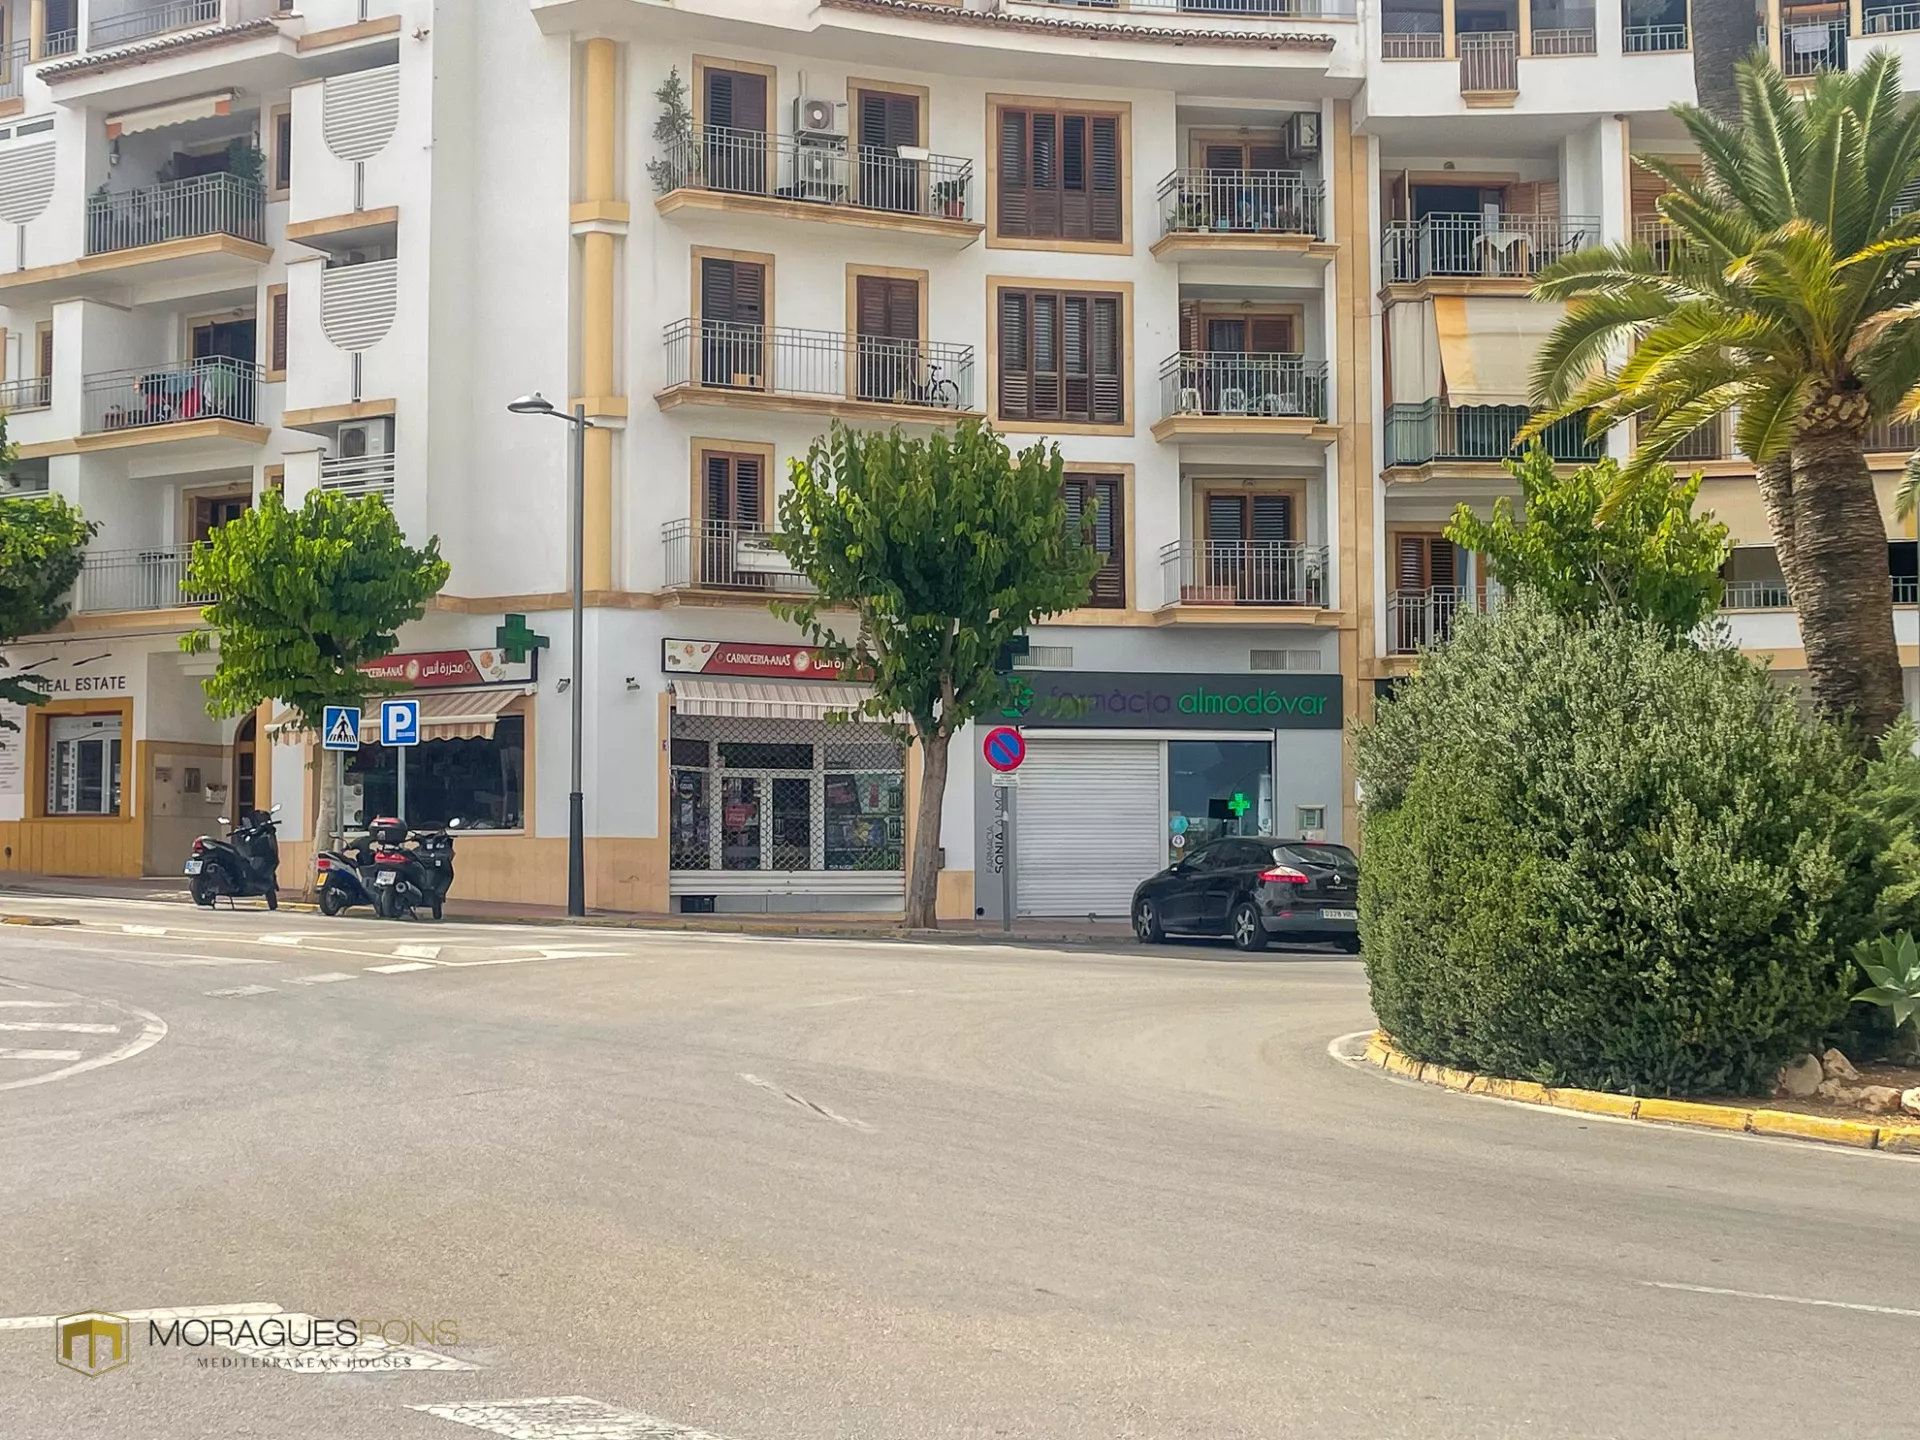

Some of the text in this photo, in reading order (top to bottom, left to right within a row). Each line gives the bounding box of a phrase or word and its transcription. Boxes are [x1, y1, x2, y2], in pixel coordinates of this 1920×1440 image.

[37, 676, 126, 693] REAL ESTATE
[1177, 687, 1329, 716] almodóvar
[388, 705, 412, 741] P
[994, 832, 1004, 874] SONIA
